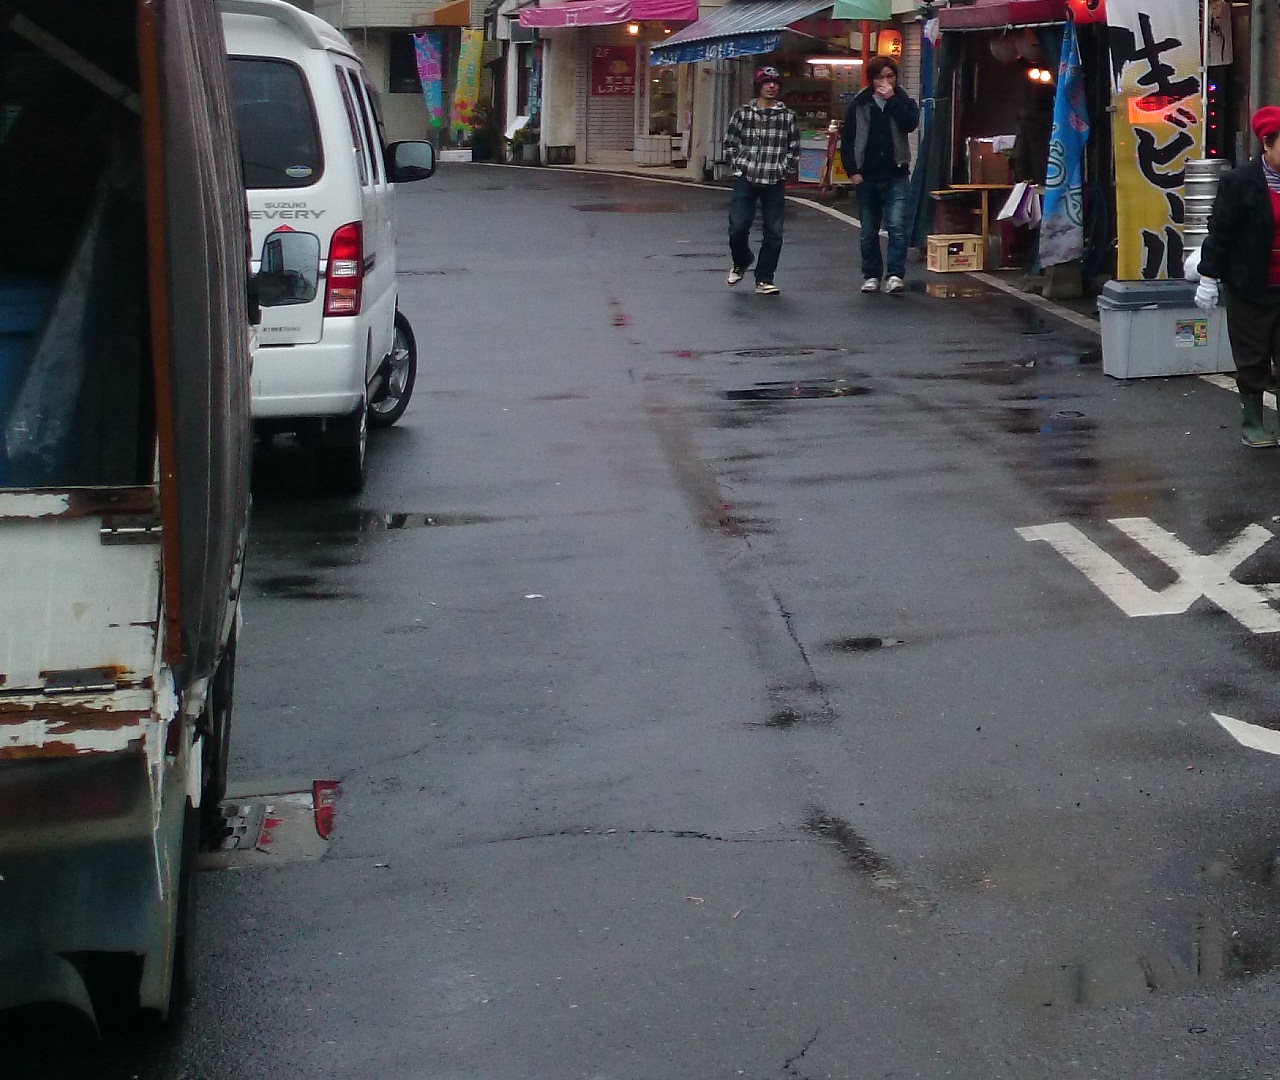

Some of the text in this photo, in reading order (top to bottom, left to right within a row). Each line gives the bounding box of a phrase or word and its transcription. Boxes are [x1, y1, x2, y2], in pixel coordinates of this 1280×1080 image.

[605, 75, 635, 86] 不二家
[1108, 12, 1201, 279] 生ビール
[264, 201, 308, 210] SUZUKI
[250, 209, 327, 220] EVERY
